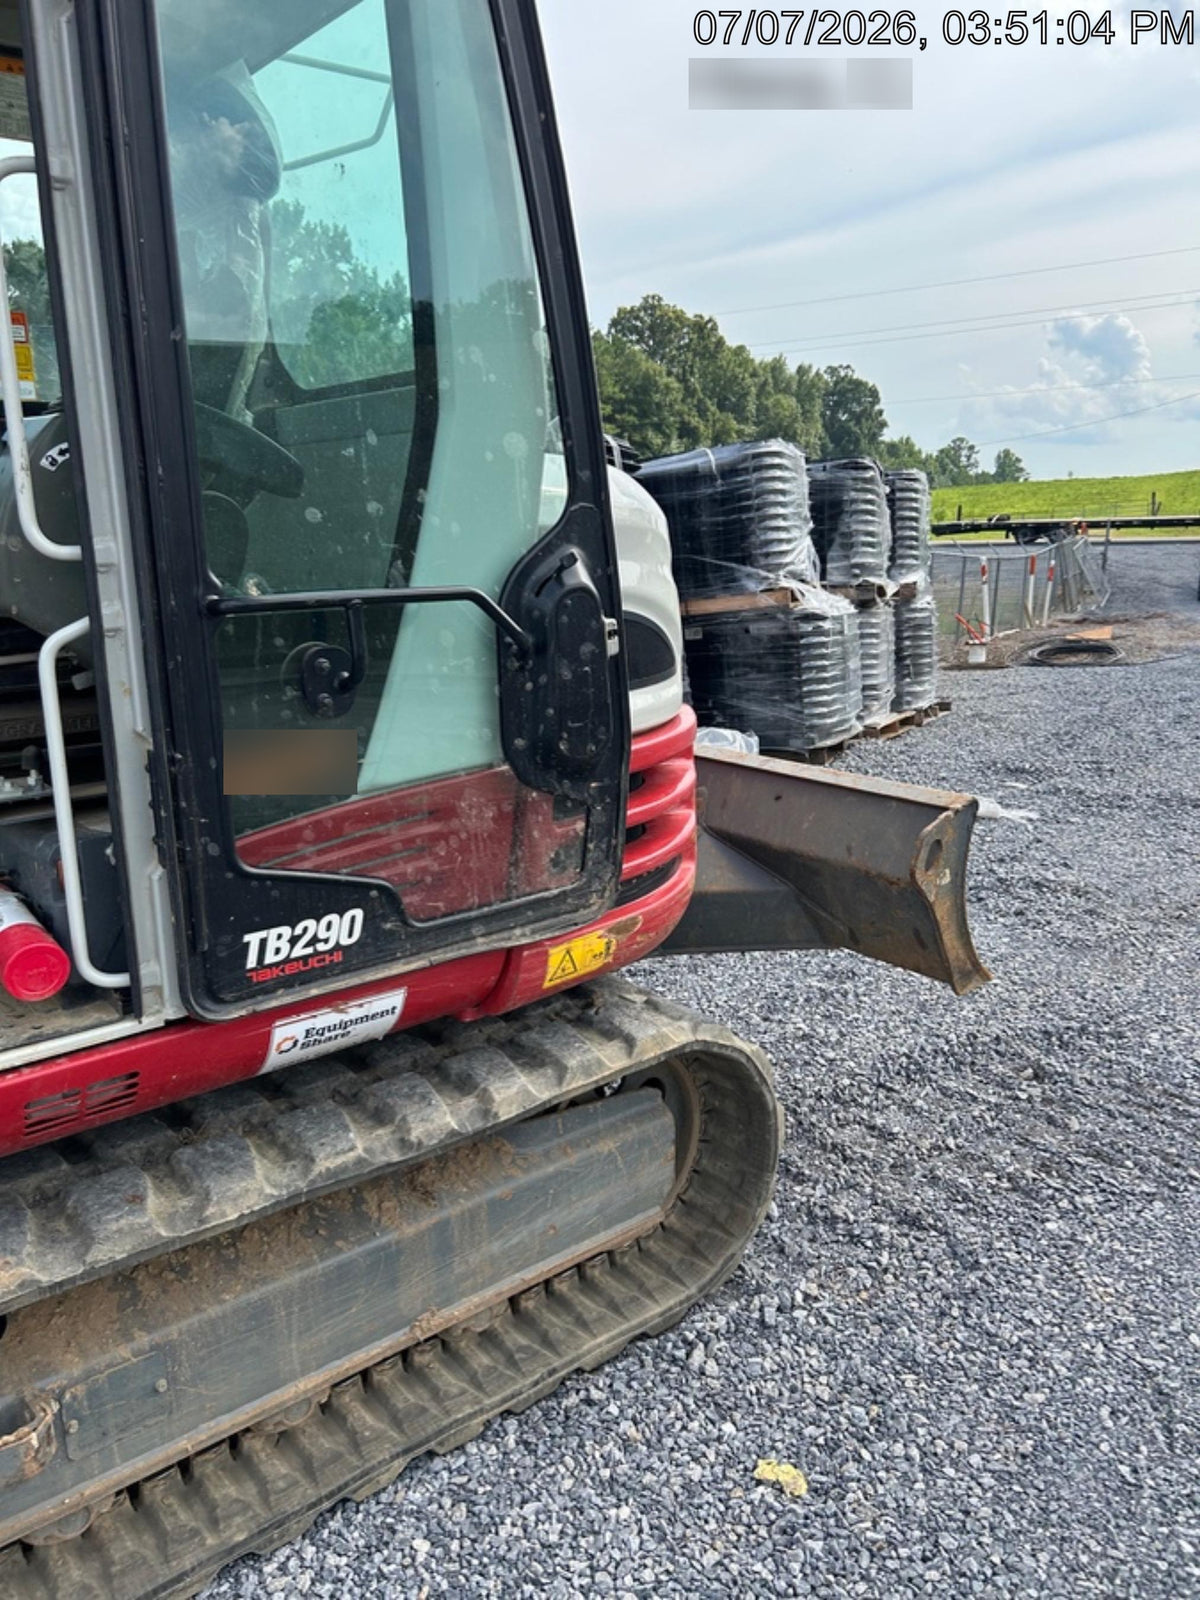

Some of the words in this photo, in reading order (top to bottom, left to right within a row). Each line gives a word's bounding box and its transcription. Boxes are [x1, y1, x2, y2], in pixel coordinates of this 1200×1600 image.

[242, 908, 364, 970] TB290
[299, 1030, 352, 1050] Share
[302, 1005, 398, 1040] Equipment
